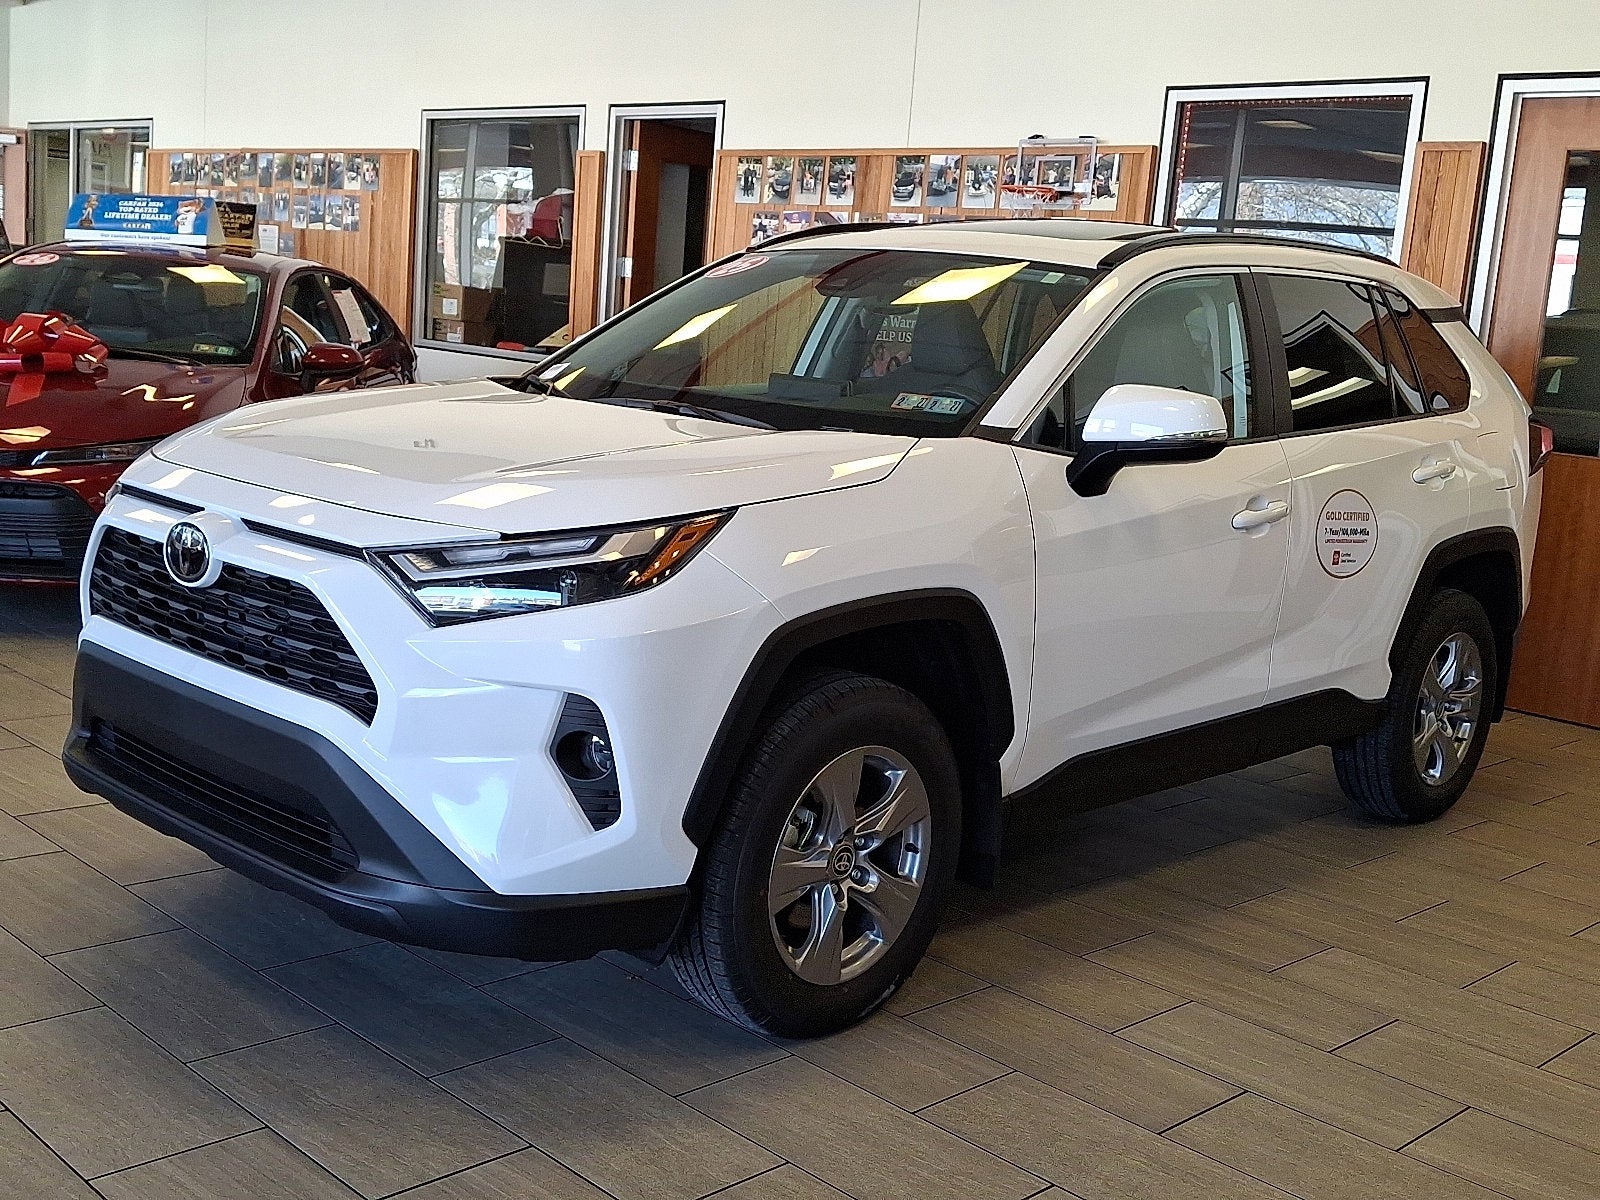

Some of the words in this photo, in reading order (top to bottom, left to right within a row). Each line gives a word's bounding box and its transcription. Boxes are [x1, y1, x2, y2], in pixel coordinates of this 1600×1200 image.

[103, 211, 140, 220] LIFETIME
[889, 315, 917, 329] Warr
[876, 330, 896, 342] ELP
[898, 331, 912, 343] US
[1326, 511, 1342, 521] GOLD
[1342, 511, 1370, 522] CERTIFIED
